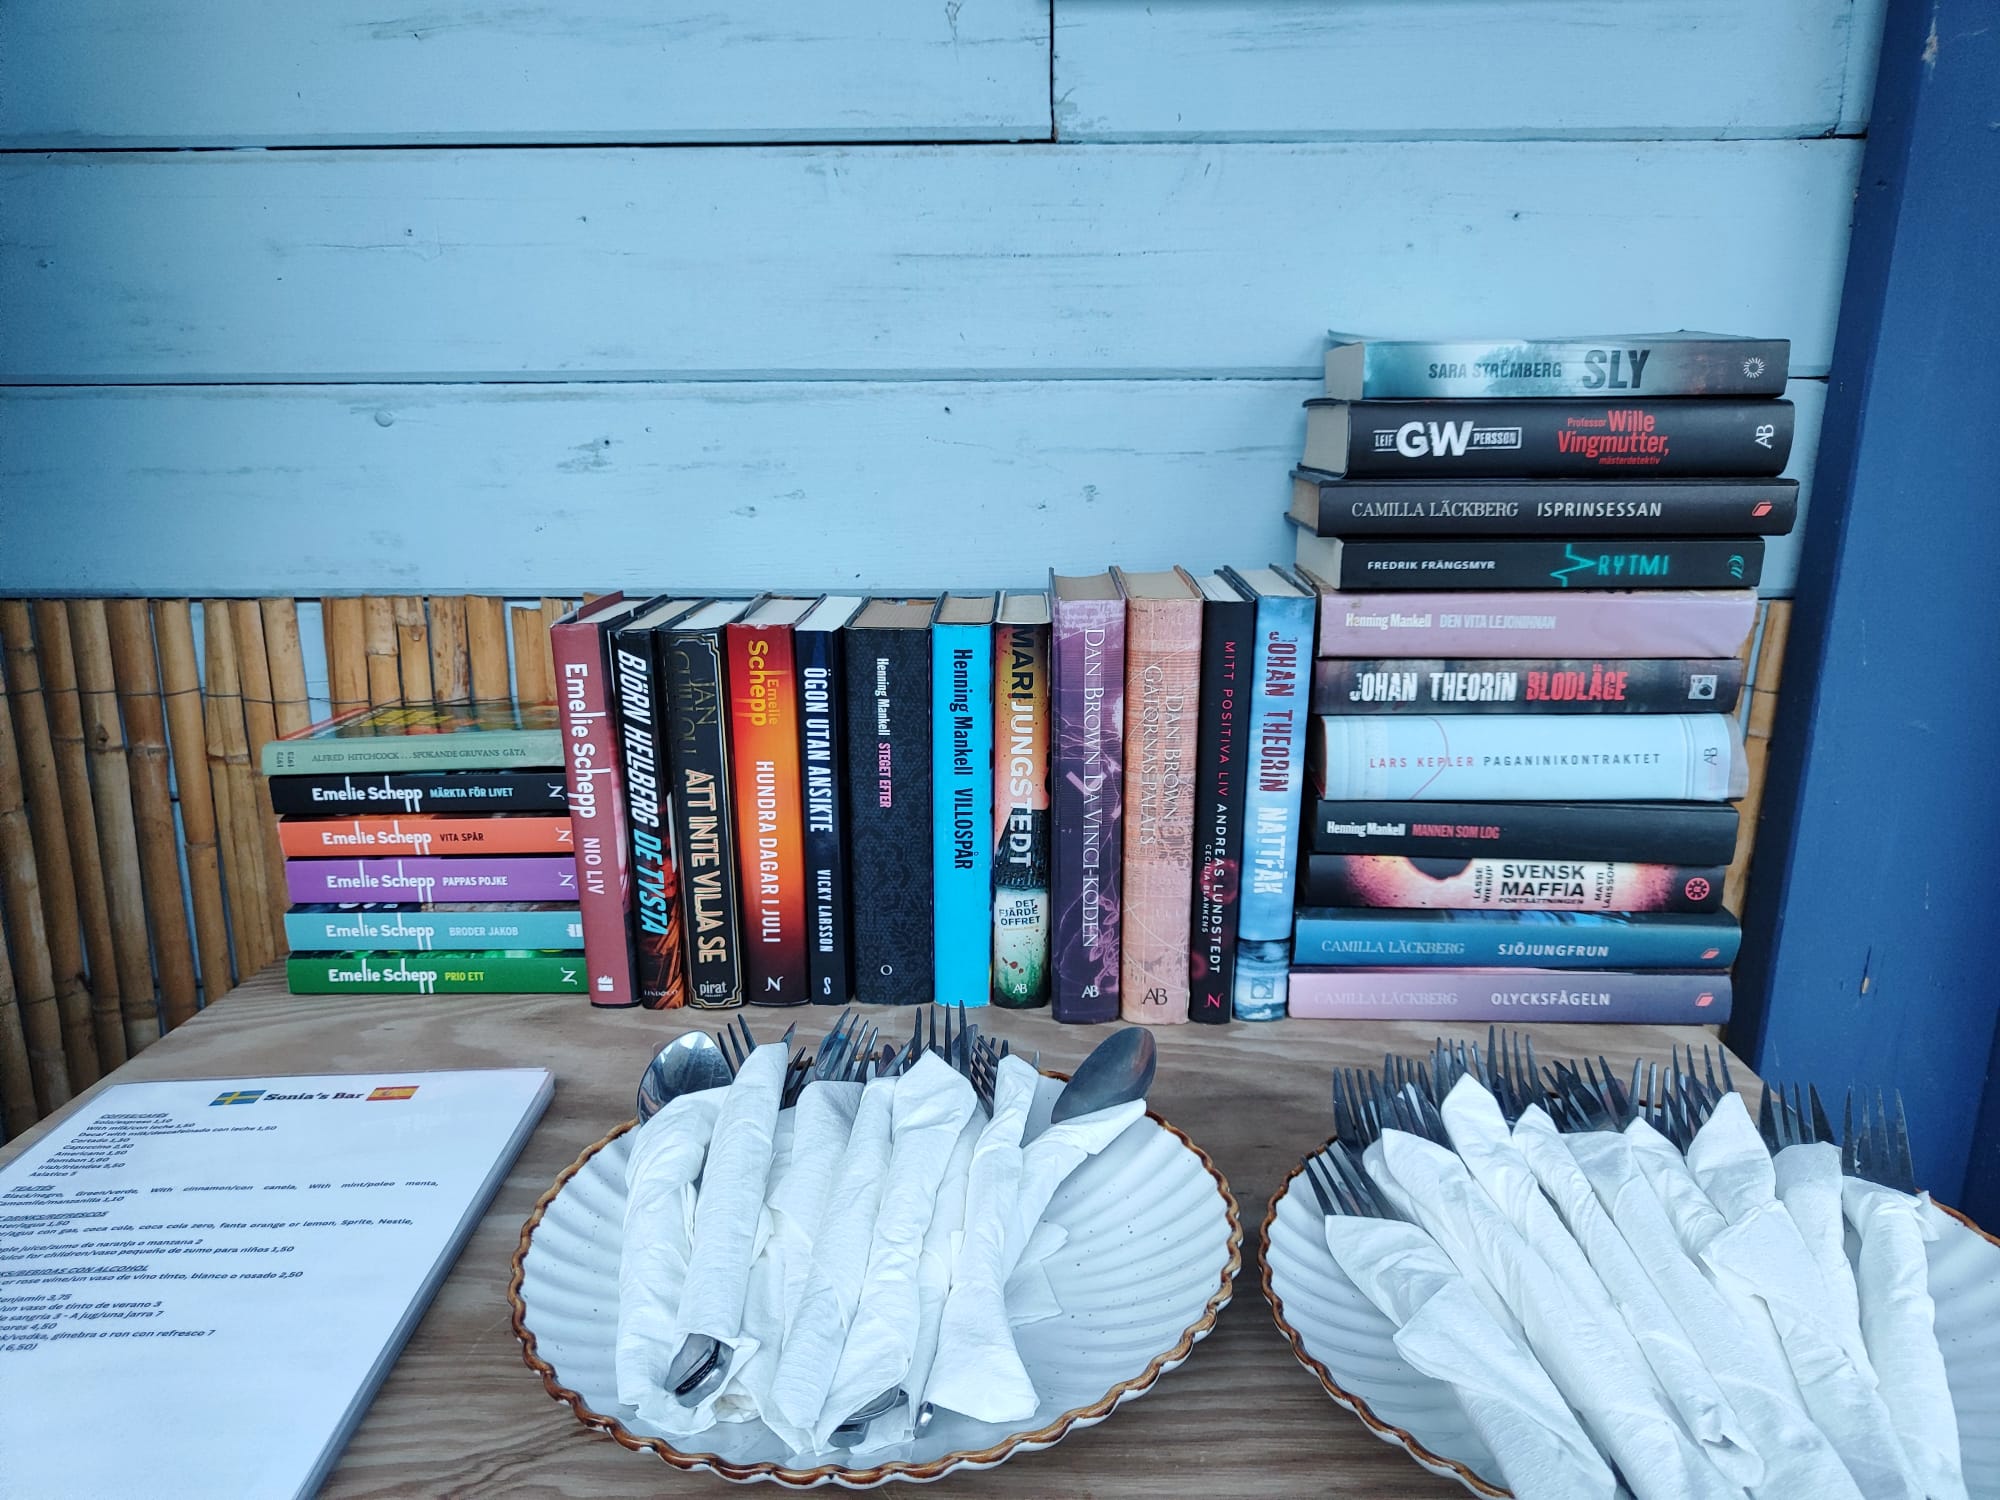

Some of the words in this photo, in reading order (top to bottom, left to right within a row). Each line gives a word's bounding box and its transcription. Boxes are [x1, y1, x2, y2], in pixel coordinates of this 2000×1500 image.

[1428, 363, 1467, 379] SARA
[1472, 360, 1562, 378] STRÖMBERG
[1582, 349, 1651, 389] SLY
[1375, 433, 1394, 447] LEIF
[1396, 420, 1474, 458] GW
[1473, 432, 1517, 445] PERSSON
[1567, 417, 1606, 428] Professor
[1607, 410, 1656, 432] Wille
[1557, 431, 1670, 458] Vingmutter,
[1598, 456, 1661, 465] mästerdetektiv
[1351, 502, 1425, 517] CAMILLA
[1429, 500, 1519, 517] LÄCKBERG
[1537, 502, 1662, 517] ISPRINSESSAN
[1367, 561, 1418, 570] FREDRIK
[1345, 613, 1389, 630] Henning
[1390, 613, 1432, 628] Mankell
[1439, 614, 1463, 628] DEN
[1464, 614, 1488, 629] VITA
[1011, 625, 1034, 699] MARI
[1085, 629, 1105, 676] DAN
[1223, 641, 1236, 680] MITT
[1265, 631, 1298, 697] JOHAN
[617, 649, 652, 725] BJÖRN
[736, 640, 787, 726] Schepp
[804, 667, 831, 713] ÖGON
[875, 658, 889, 697] Henning
[950, 649, 974, 713] Henning
[1349, 672, 1418, 701] JOHAN
[1429, 672, 1518, 701] THEORIN
[565, 663, 606, 738] Emelie
[689, 680, 717, 725] JAN
[767, 679, 781, 725] Emelie
[877, 699, 890, 736] Mankell
[1142, 666, 1163, 774] GATORNAS
[1165, 695, 1184, 739] DAN
[806, 719, 830, 761] UTAN
[1084, 687, 1105, 765] BROWN
[1219, 689, 1234, 763] POSITIVA
[311, 754, 344, 762] ALFRED
[878, 742, 890, 778] STEGET
[953, 716, 973, 776] Mankell
[1259, 709, 1293, 792] THEORIN
[1370, 758, 1407, 768] LARS
[1417, 756, 1474, 767] KEPLER
[1484, 754, 1660, 766] PAGANINIKONTRAKTET
[312, 776, 366, 801] Emelie
[368, 775, 423, 813] Schepp
[430, 787, 467, 799] MÄRKTA
[469, 786, 486, 798] FÖR
[488, 787, 513, 797] LIVET
[567, 743, 611, 819] Schepp
[623, 724, 660, 828] HELLBERG
[685, 768, 717, 813] ATT
[879, 779, 892, 808] EFTER
[1009, 701, 1034, 868] JUNGSTEDT
[1162, 749, 1182, 820] BROWN
[1217, 772, 1229, 796] LIV
[755, 760, 776, 833] HUNDRA
[808, 766, 833, 832] ANSIKTE
[322, 820, 375, 846] Emelie
[377, 819, 432, 855] Schepp
[440, 833, 459, 843] VITA
[461, 831, 484, 842] SPÅR
[633, 829, 663, 866] DE
[689, 816, 720, 867] INTE
[954, 788, 979, 870] VILLOSPÅR
[1213, 803, 1228, 877] ANDREAS
[1327, 821, 1366, 838] Henning
[1367, 822, 1406, 836] Mankell
[1412, 824, 1454, 837] MANNEN
[1455, 825, 1479, 838] SOM
[1480, 826, 1500, 839] LOG
[583, 838, 602, 866] NIO
[759, 837, 779, 894] DAGAR
[1203, 844, 1212, 881] CECILIA
[327, 860, 379, 888] Emelie
[381, 859, 435, 902] Schepp
[442, 876, 476, 887] PAPPAS
[478, 876, 508, 886] POJKE
[586, 870, 605, 895] LIV
[817, 869, 832, 901] VICKY
[1082, 808, 1102, 947] VINCI-KODEN
[1500, 882, 1585, 897] MAFFIA
[1503, 864, 1585, 880] SVENSK
[637, 866, 668, 935] TYSTA
[693, 871, 724, 932] VILJA
[999, 907, 1038, 917] FJÄRDE
[1015, 899, 1035, 908] DET
[1201, 885, 1211, 933] BLANKENS
[326, 913, 378, 937] Emelie
[381, 912, 435, 950] Schepp
[449, 927, 485, 937] BRODER
[488, 926, 518, 937] JAKOB
[761, 908, 781, 943] JULI
[818, 905, 834, 952] LARSSON
[1000, 915, 1040, 926] OFFRET
[1209, 884, 1224, 973] LUNDSTEDT
[698, 936, 727, 963] SE
[1321, 940, 1384, 953] CAMILLA
[1388, 940, 1465, 954] LÄCKBERG
[1498, 943, 1609, 957] SJÖJUNGFRUN
[328, 958, 380, 982] Emelie
[383, 957, 437, 994] Schepp
[445, 971, 465, 981] PRIO
[468, 971, 484, 981] ETT
[700, 981, 727, 995] pirat
[1491, 990, 1611, 1006] OLYCKSFÅGELN
[264, 1092, 330, 1101] Sonia's
[333, 1092, 365, 1100] Bar
